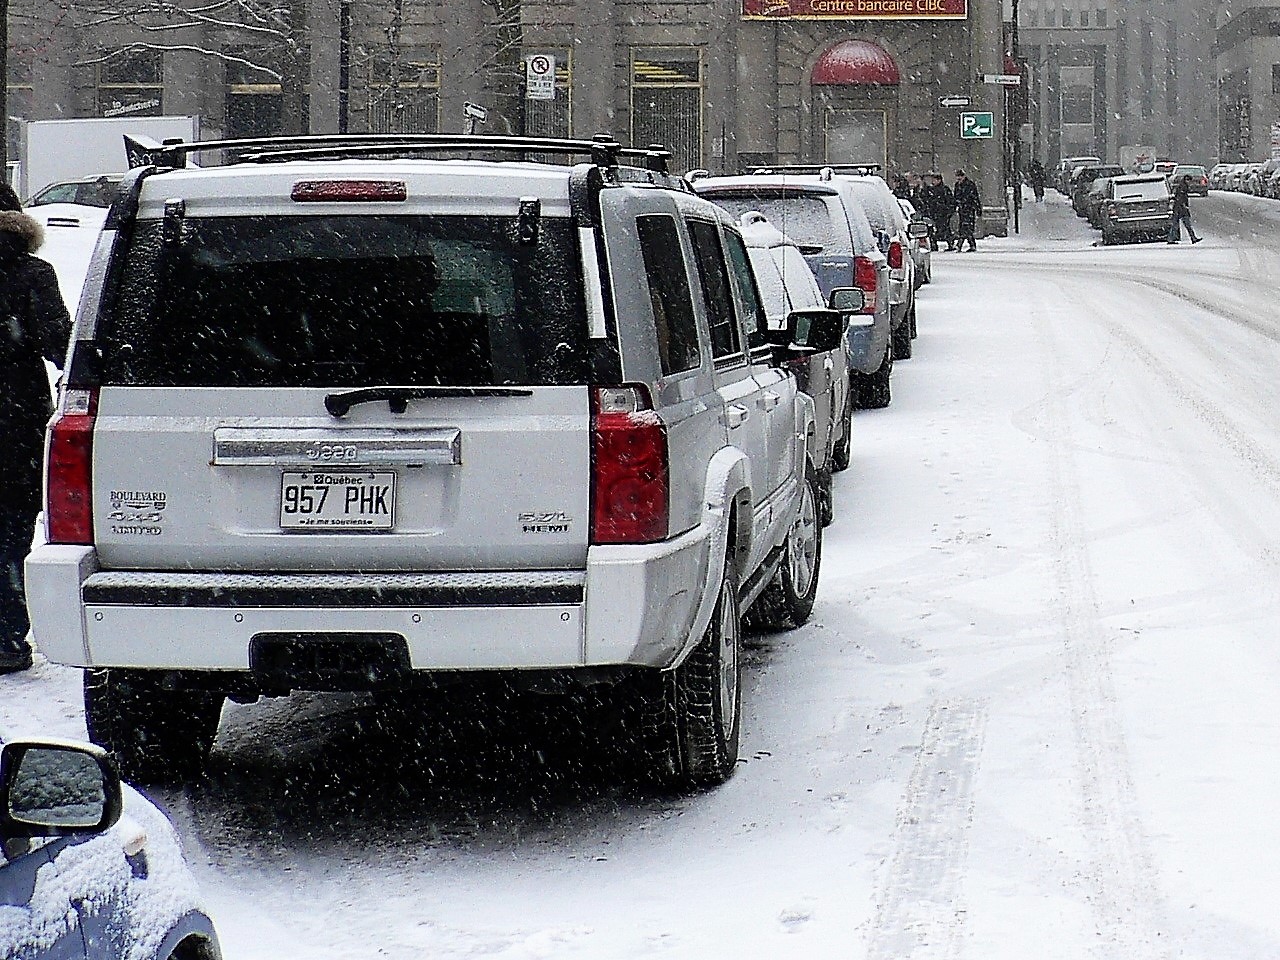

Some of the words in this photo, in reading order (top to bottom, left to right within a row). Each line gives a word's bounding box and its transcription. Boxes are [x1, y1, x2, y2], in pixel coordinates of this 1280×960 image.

[324, 474, 363, 485] Québec
[110, 490, 167, 502] BOULEVARD
[284, 485, 330, 514] 957
[344, 485, 390, 515] PHK
[522, 525, 568, 533] HEMI
